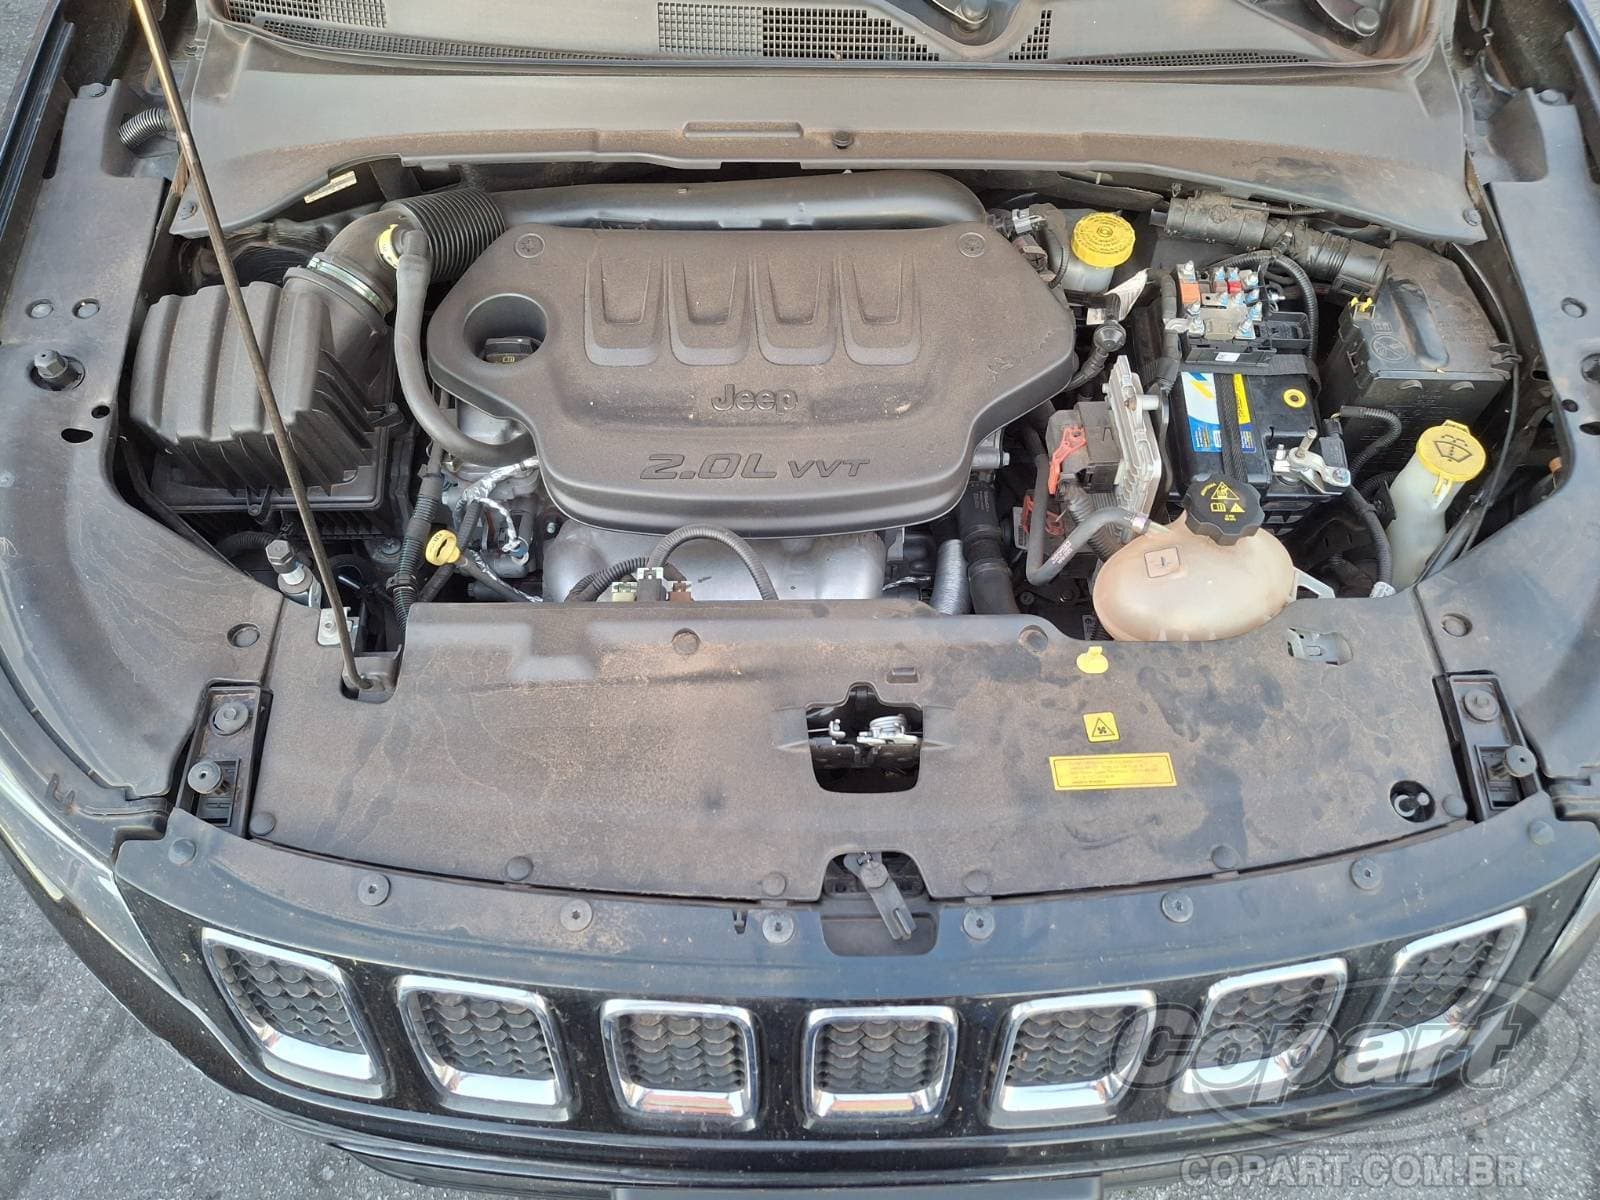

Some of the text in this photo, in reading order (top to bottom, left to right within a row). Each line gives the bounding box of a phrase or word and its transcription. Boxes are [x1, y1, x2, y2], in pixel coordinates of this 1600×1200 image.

[711, 384, 798, 415] Jeep
[640, 453, 870, 480] 2.0L VVT
